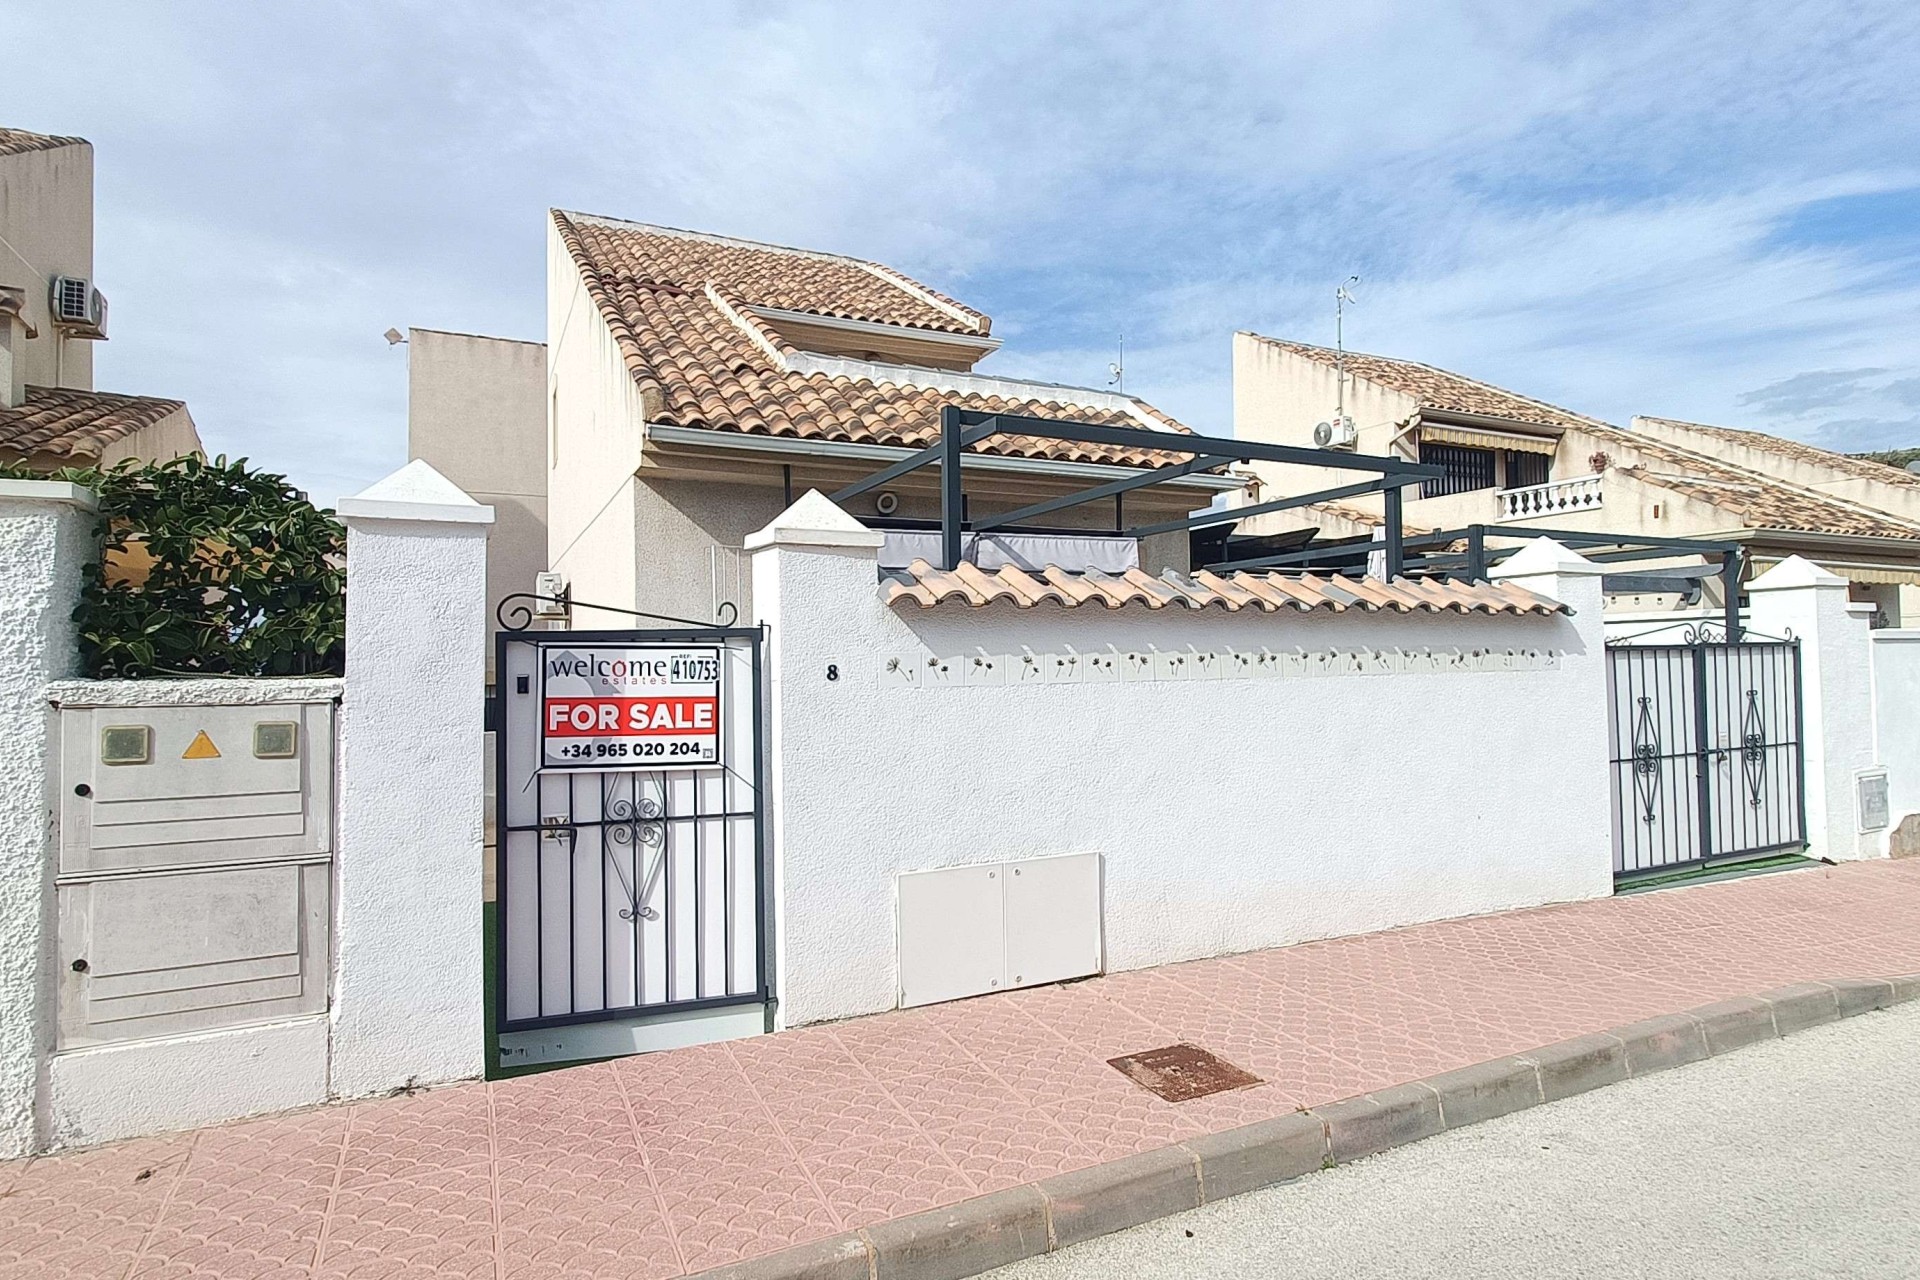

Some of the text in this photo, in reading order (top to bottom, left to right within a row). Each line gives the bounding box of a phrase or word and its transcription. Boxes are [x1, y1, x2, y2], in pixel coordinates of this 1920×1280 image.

[551, 654, 667, 678] welcome
[673, 660, 718, 680] 410753
[827, 664, 838, 681] 8
[602, 677, 667, 685] estates
[549, 703, 713, 730] FOR SALE
[561, 742, 700, 758] +34 965 020 204
